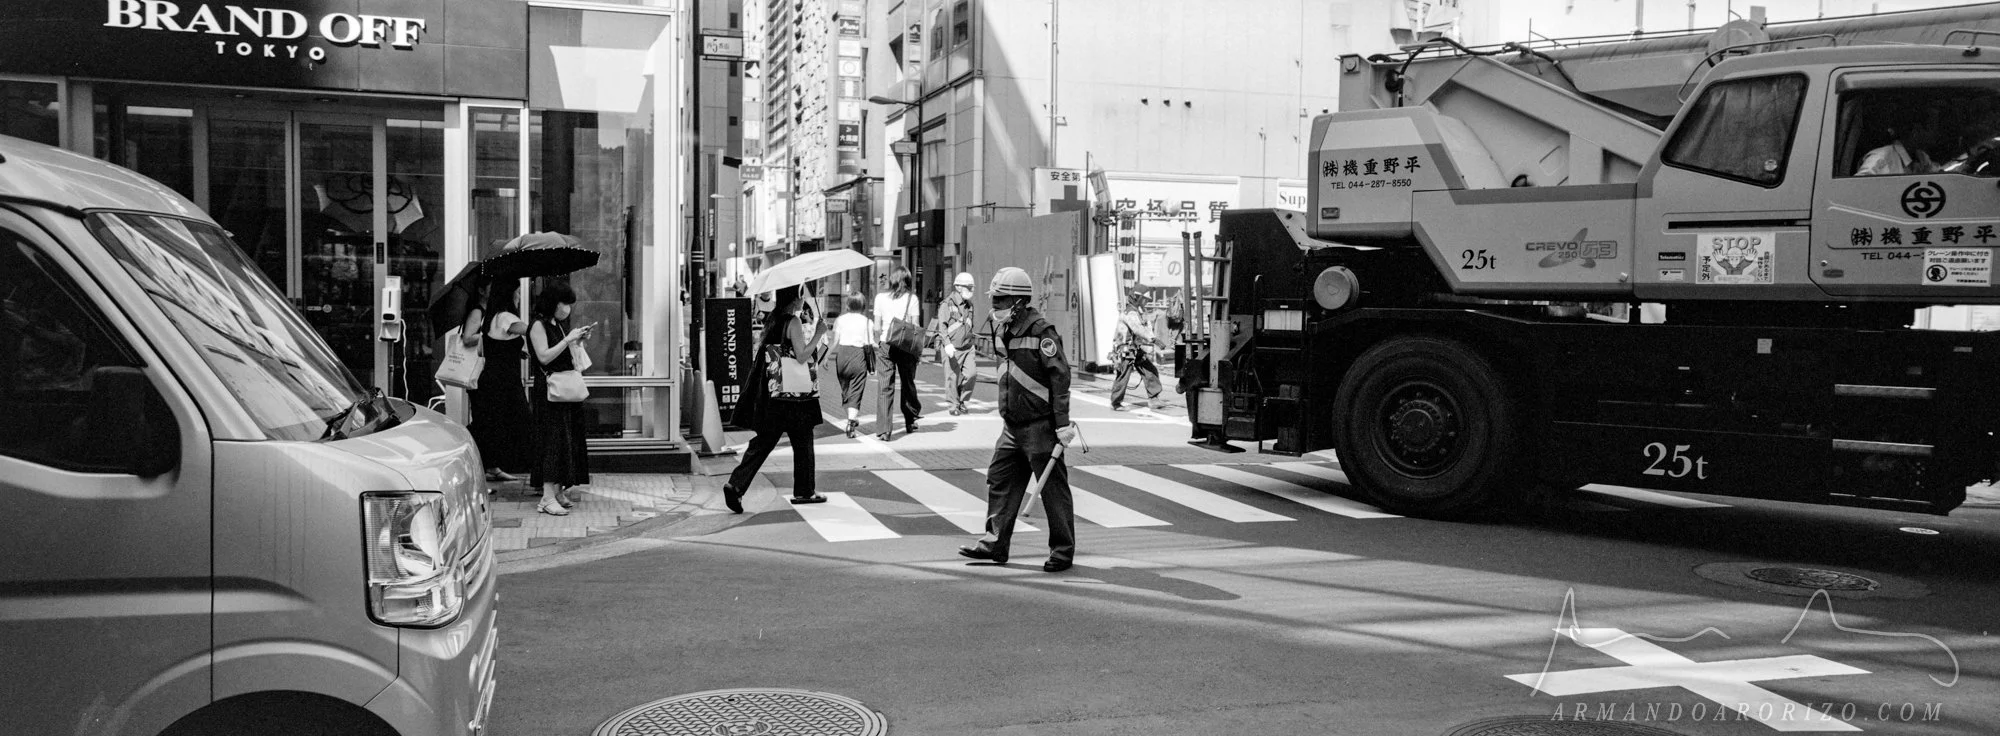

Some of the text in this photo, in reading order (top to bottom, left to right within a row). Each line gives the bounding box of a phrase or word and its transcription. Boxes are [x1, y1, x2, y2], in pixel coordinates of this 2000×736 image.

[103, 0, 426, 47] BRAND OFF
[215, 41, 325, 61] TOKYO
[1331, 178, 1412, 190] TEL 044-287-8550
[1525, 241, 1578, 251] CREVO
[1711, 236, 1762, 250] STOP
[1461, 249, 1497, 270] 25t
[1558, 251, 1578, 259] 250
[1861, 252, 1883, 260] TEL
[1701, 256, 1711, 281] 予定外
[727, 308, 738, 380] BRAND OFF
[1642, 442, 1709, 480] 25t
